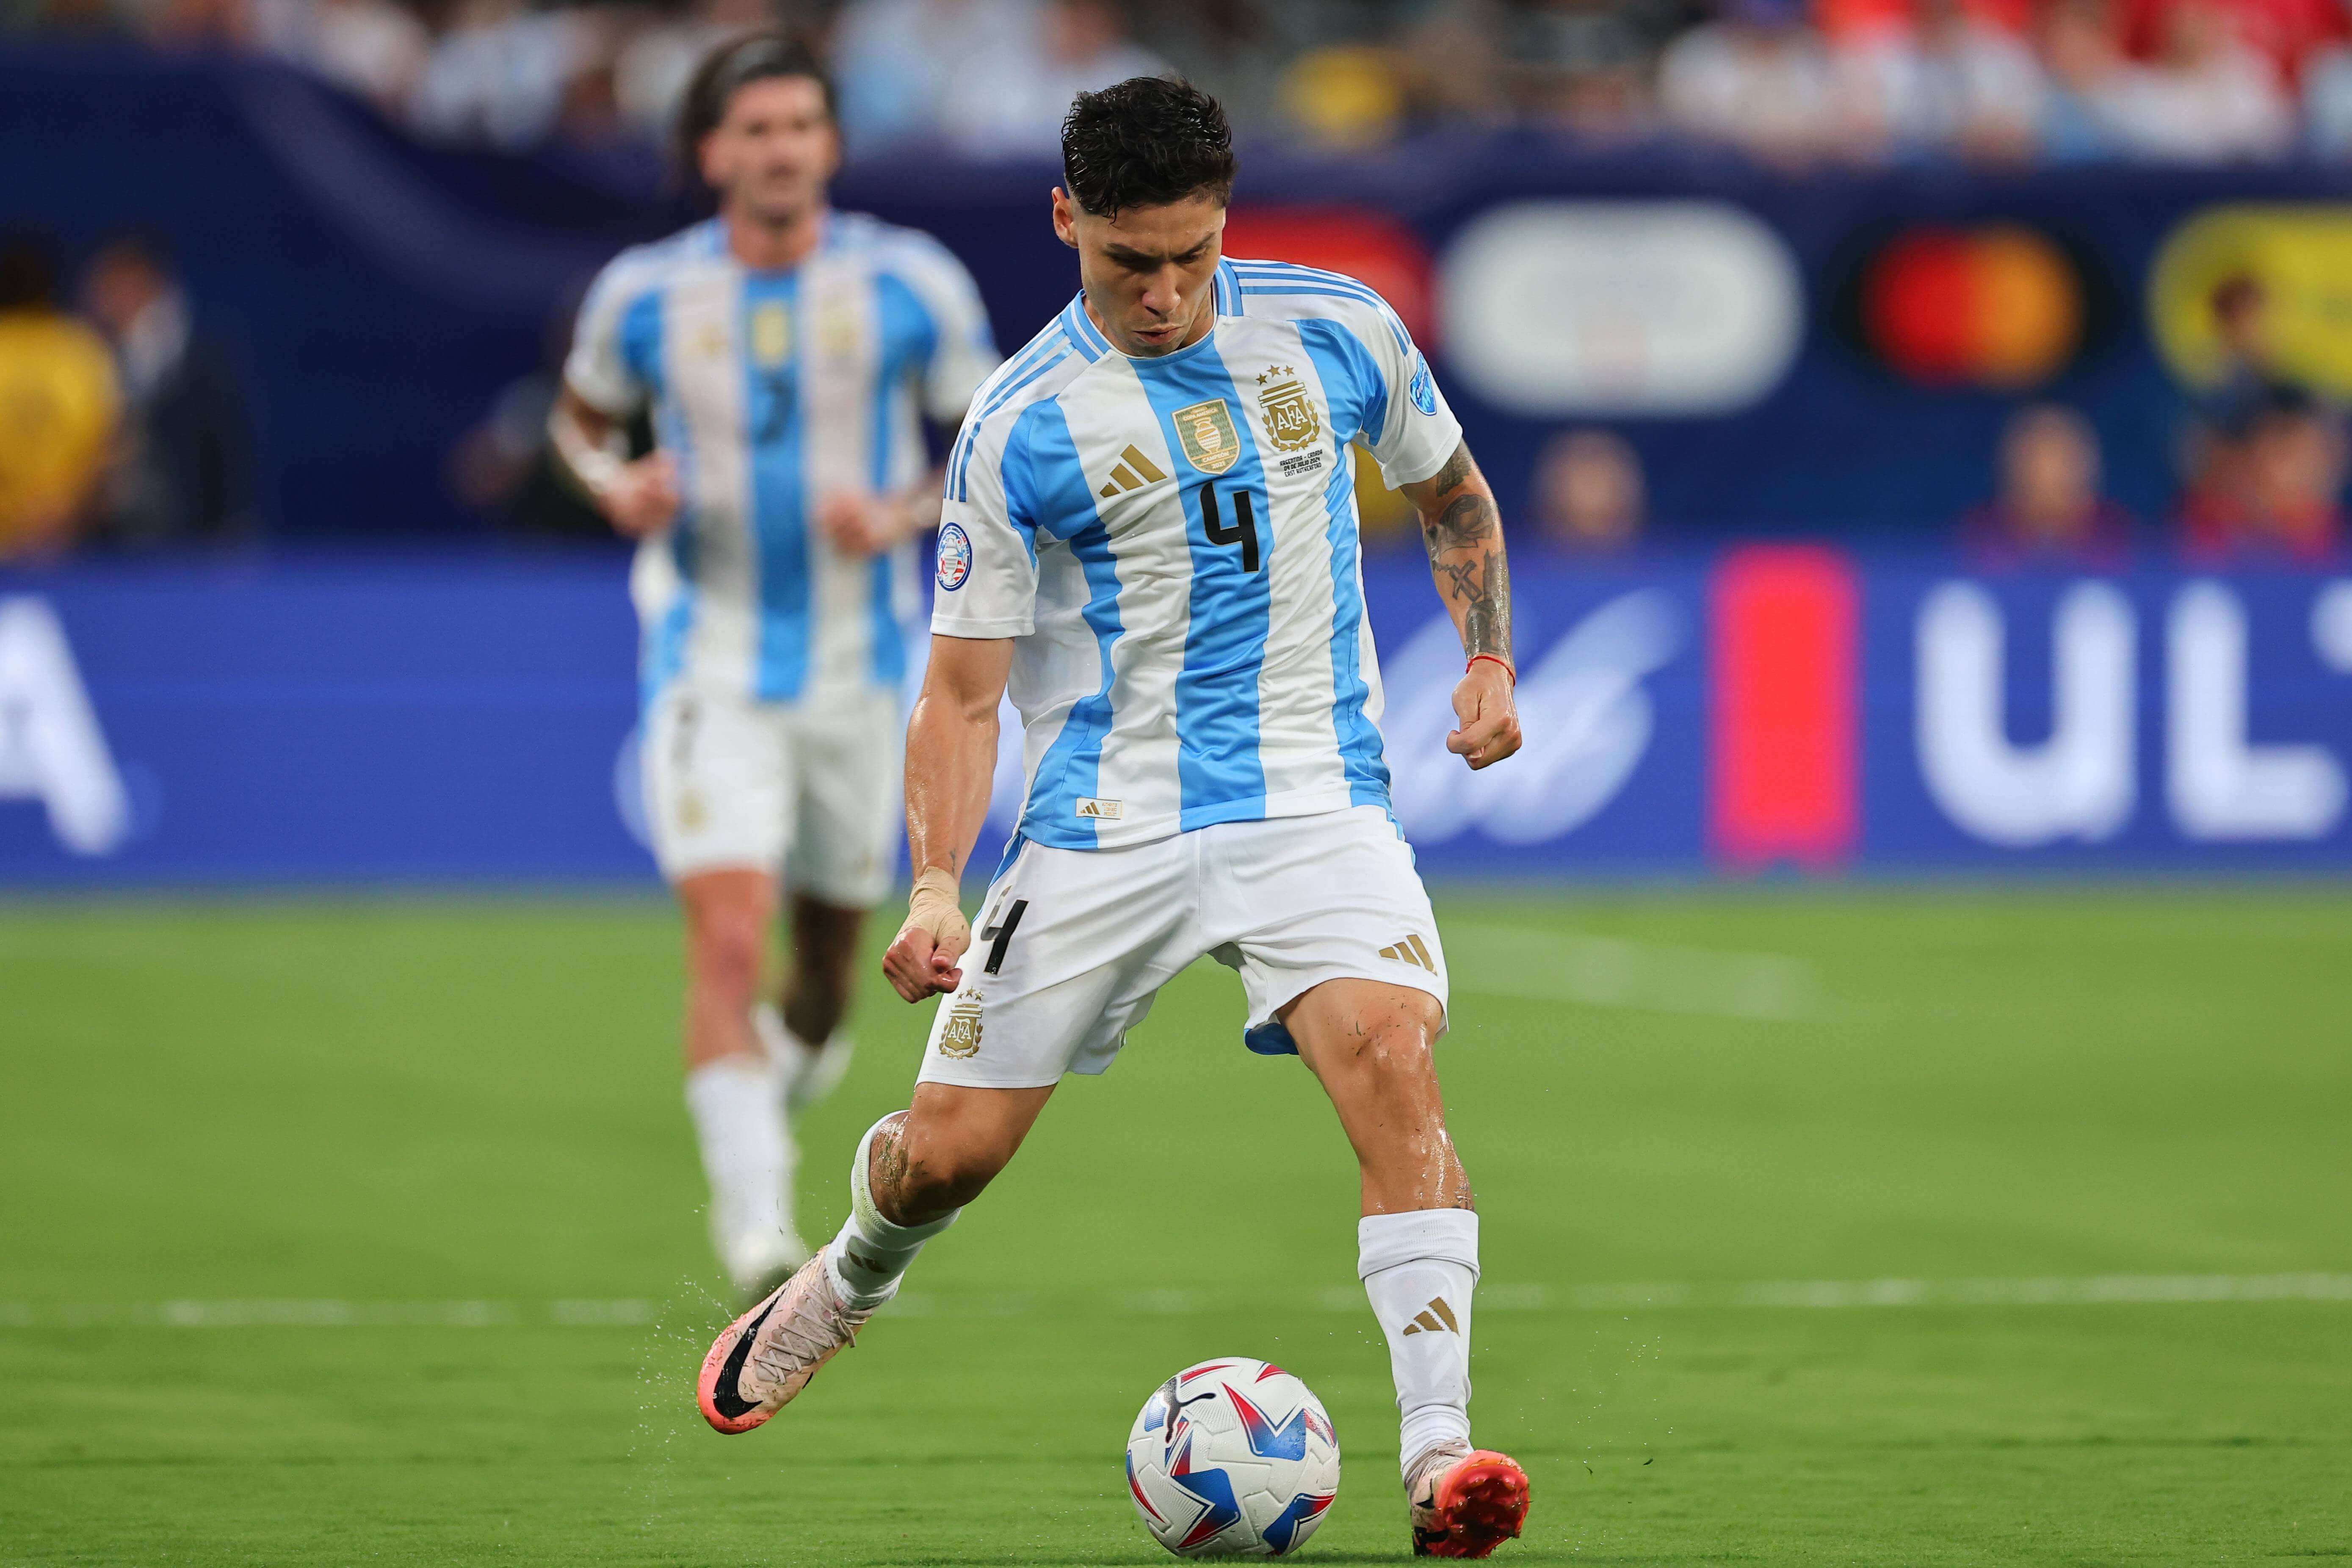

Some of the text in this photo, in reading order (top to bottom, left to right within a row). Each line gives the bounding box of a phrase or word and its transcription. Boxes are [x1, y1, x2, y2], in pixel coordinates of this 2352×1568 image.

[1274, 400, 1308, 431] AFA
[1280, 456, 1303, 466] ARGENTINA
[1307, 449, 1323, 458] CANADA
[1296, 462, 1322, 474] RUTHERFORD
[1297, 460, 1309, 468] JULIO
[1199, 481, 1259, 572] 4
[1916, 581, 2352, 846] UL
[980, 885, 1029, 975] 4
[948, 1017, 972, 1044] AFA
